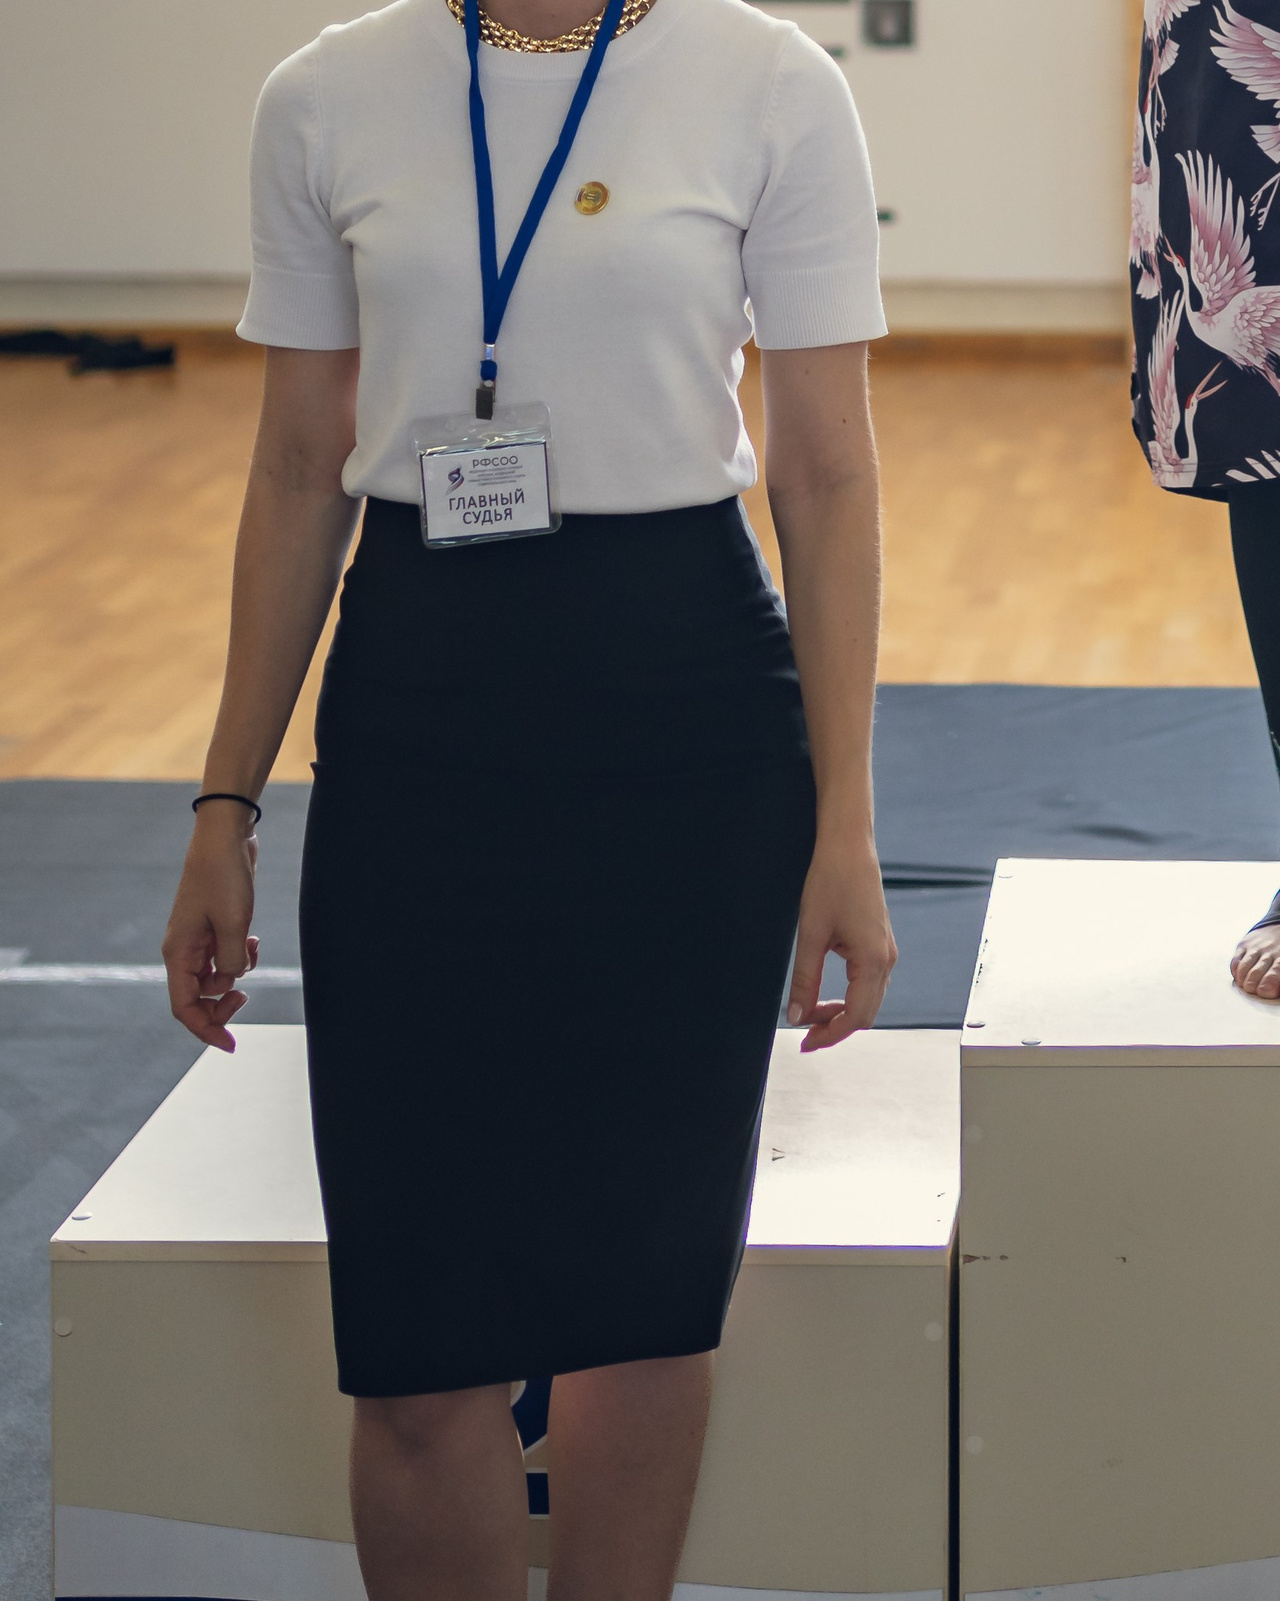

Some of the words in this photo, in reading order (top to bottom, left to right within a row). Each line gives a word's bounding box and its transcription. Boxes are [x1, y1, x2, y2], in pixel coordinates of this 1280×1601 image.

[472, 455, 519, 469] РФСОО
[449, 488, 525, 511] ГЛАВНЫЙ
[462, 507, 513, 526] СУДЬЯ
